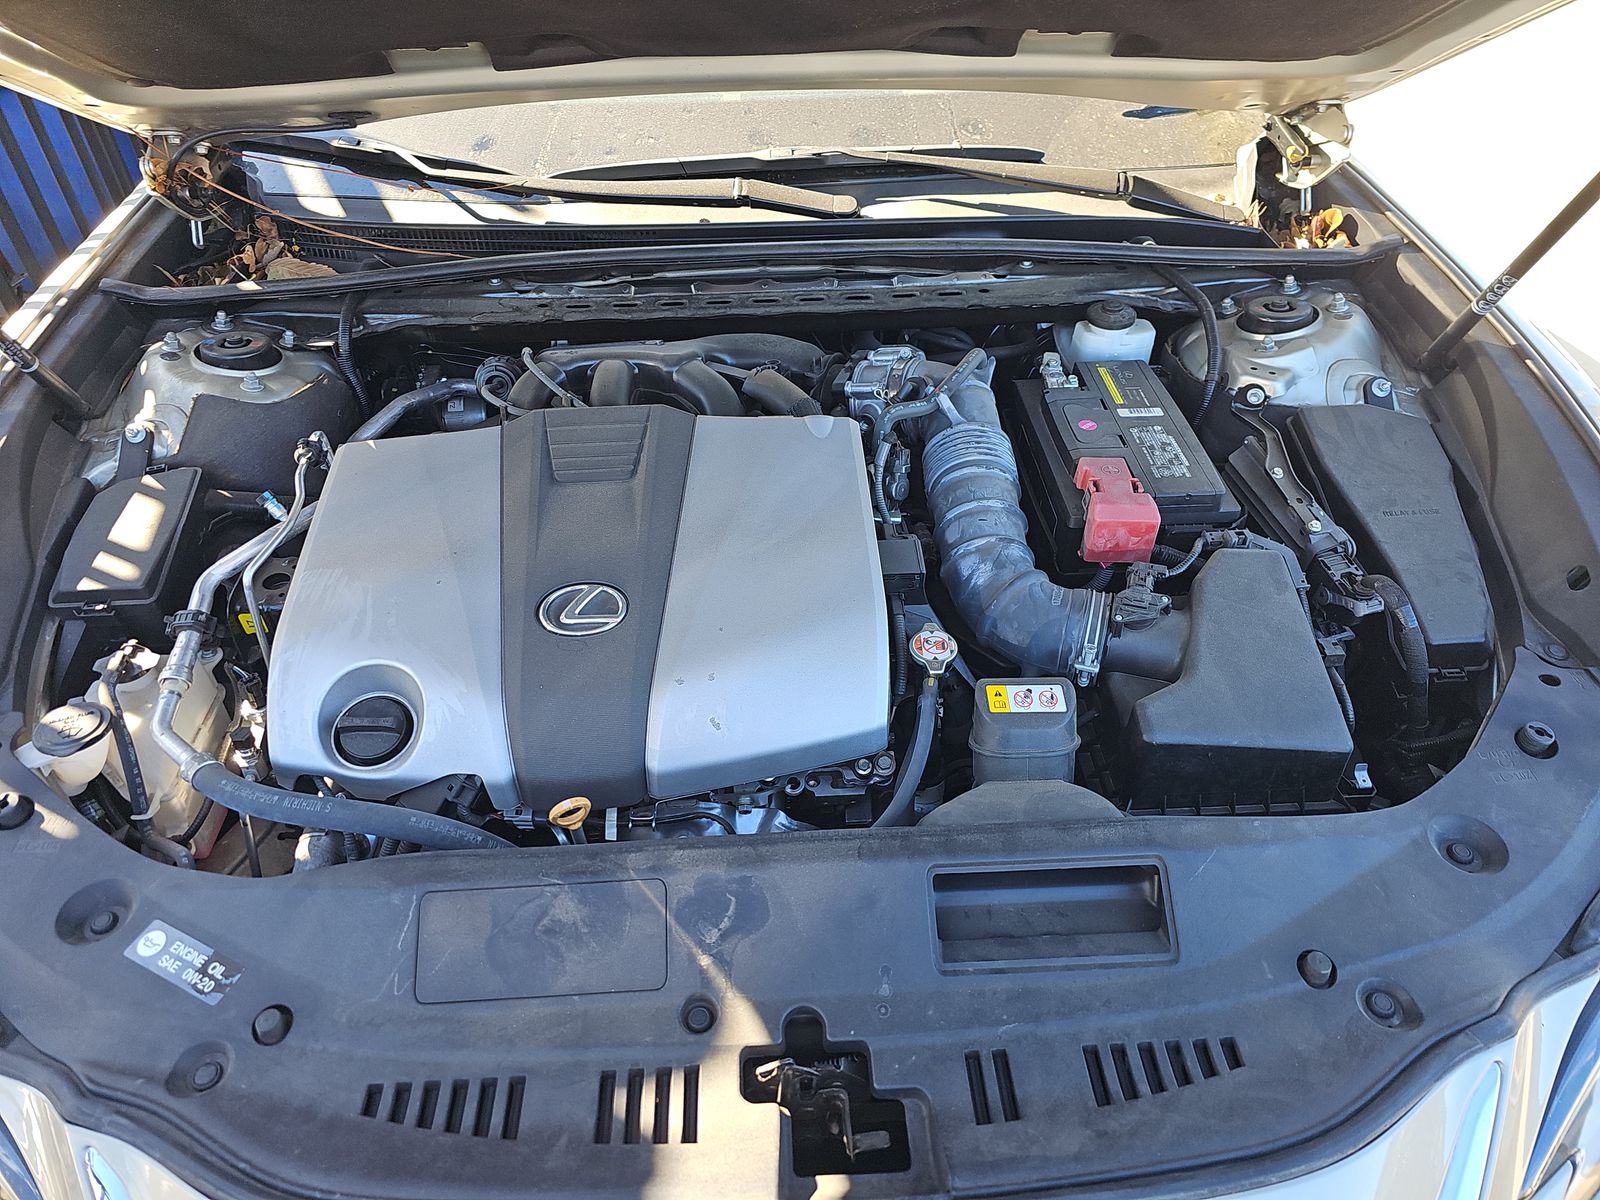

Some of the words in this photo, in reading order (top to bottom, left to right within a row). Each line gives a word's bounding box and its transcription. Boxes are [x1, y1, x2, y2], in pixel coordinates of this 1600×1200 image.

[158, 955, 182, 973] SAE
[182, 968, 215, 992] 0W-20
[170, 941, 208, 967] ENGINE
[207, 962, 226, 980] OIL
